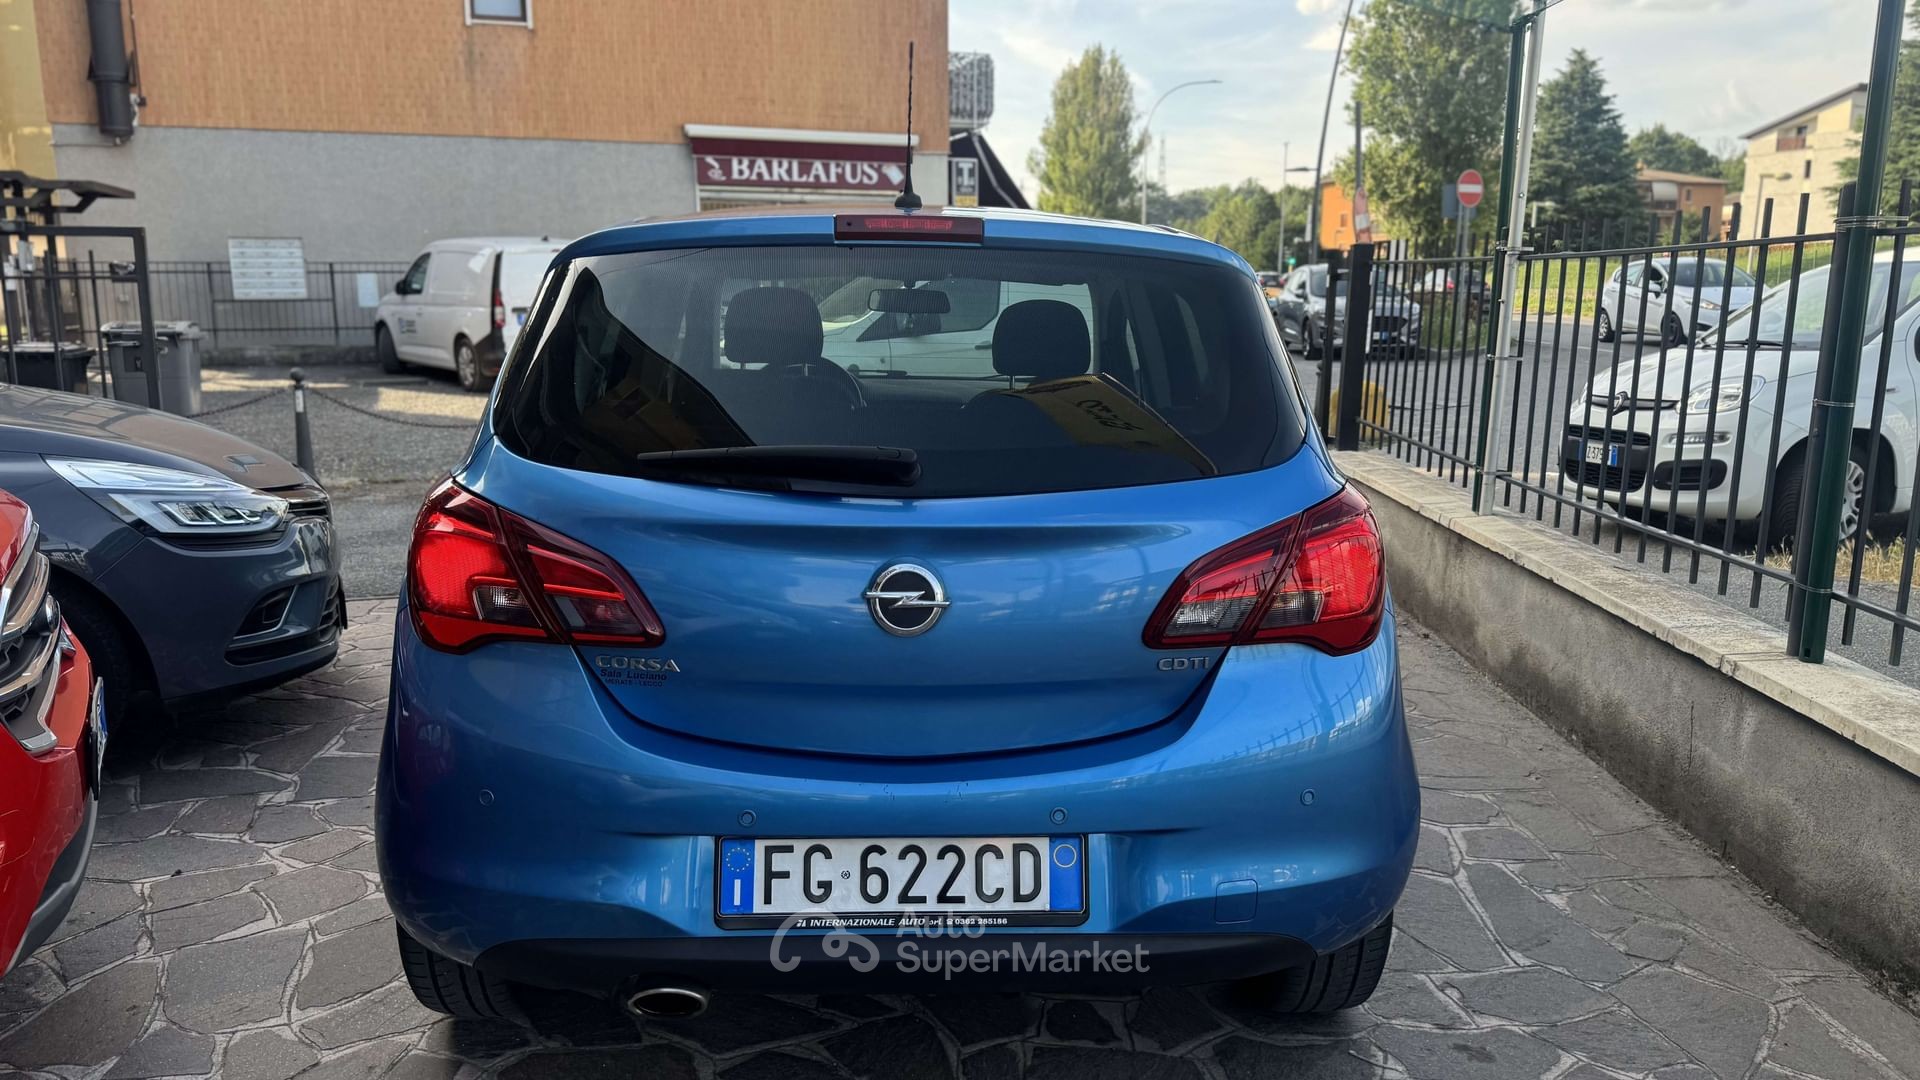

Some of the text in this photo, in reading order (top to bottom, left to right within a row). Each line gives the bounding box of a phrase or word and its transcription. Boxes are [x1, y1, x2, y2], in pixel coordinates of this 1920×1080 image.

[730, 156, 879, 185] BARLAFUS
[595, 655, 680, 672] CORSA
[1158, 656, 1209, 671] CDTI
[600, 669, 668, 681] Sala Luciano
[809, 917, 896, 928] INTERNAZIONALE
[898, 917, 926, 926] AUTO
